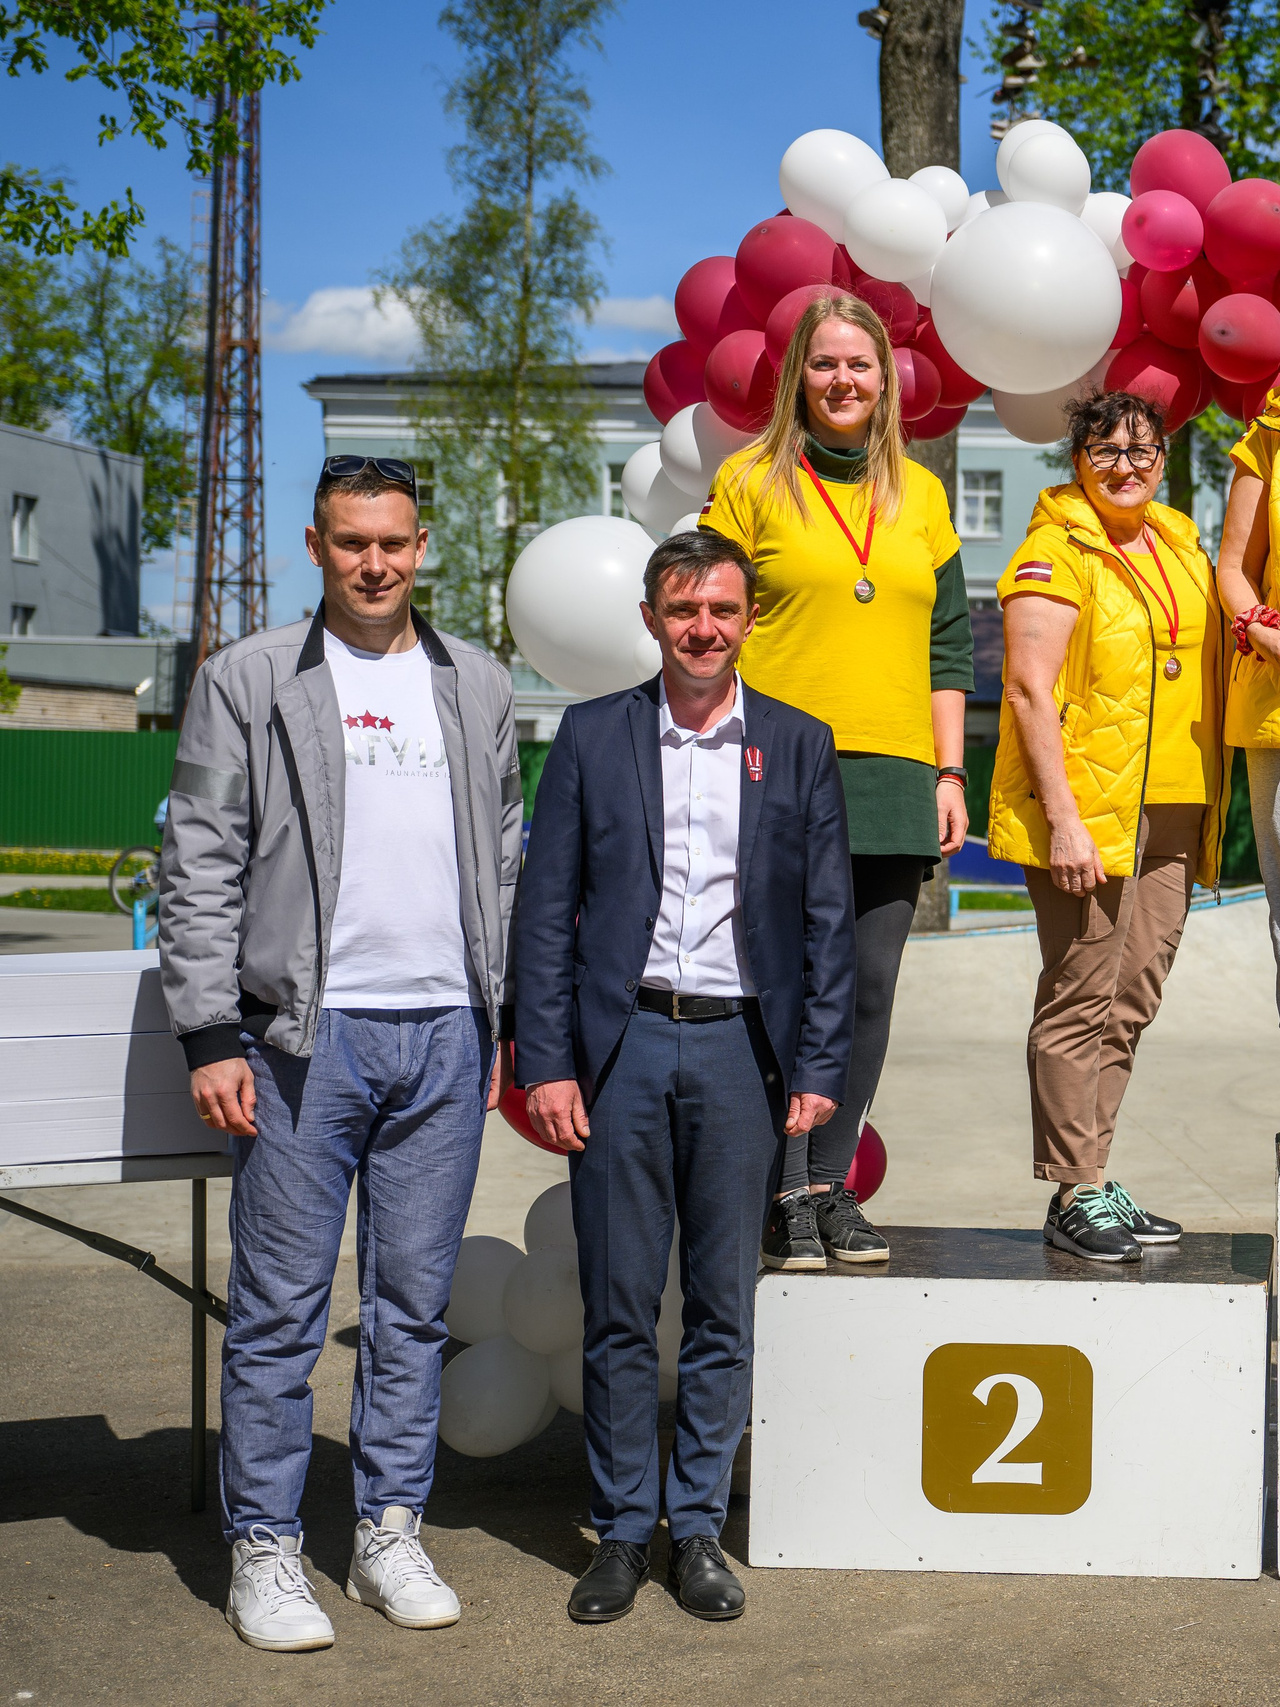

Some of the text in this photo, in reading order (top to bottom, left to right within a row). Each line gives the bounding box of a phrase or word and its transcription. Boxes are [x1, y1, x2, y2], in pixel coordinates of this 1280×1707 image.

[345, 734, 446, 768] ATVIJ
[385, 769, 440, 778] JAUNATNES
[971, 1373, 1044, 1485] 2
